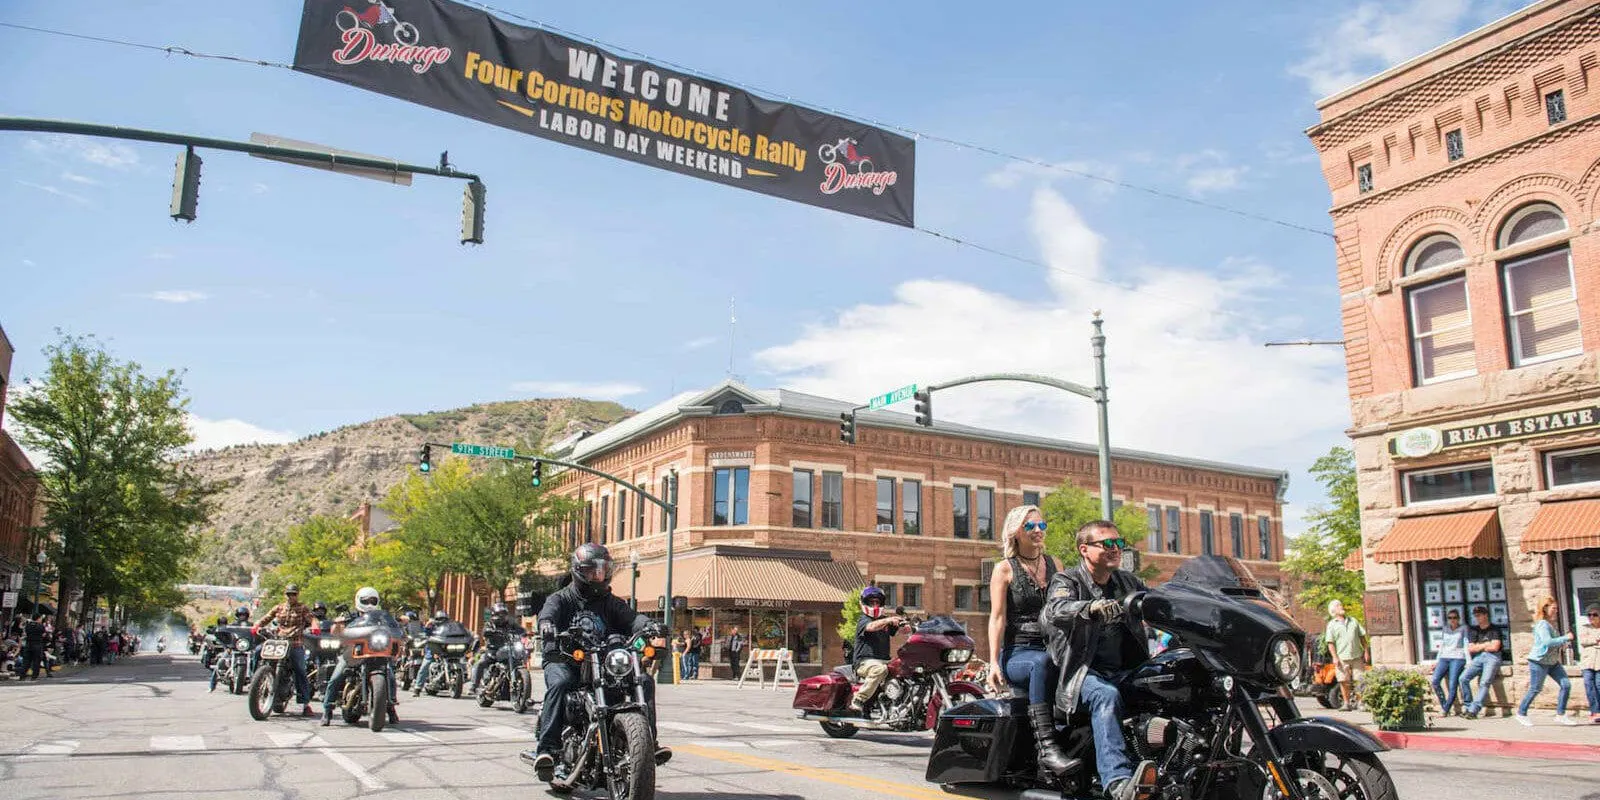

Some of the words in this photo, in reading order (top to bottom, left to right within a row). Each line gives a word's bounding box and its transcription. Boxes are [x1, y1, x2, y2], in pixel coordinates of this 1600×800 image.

[332, 27, 451, 74] Durango
[568, 48, 730, 122] WELCOME
[464, 51, 523, 93] Four
[526, 69, 624, 122] Corners
[628, 99, 751, 156] Motorcycle
[755, 134, 807, 172] Rally
[539, 108, 606, 144] LABOR
[613, 129, 650, 155] DAY
[656, 140, 742, 179] WEEKEND
[819, 162, 897, 195] Durango
[872, 394, 887, 409] MAIN
[890, 386, 912, 404] AVENUE
[1449, 424, 1502, 445] REAL
[1508, 408, 1593, 435] ESTATE
[457, 445, 474, 455] 9TH
[479, 447, 509, 458] STREET
[263, 644, 286, 656] 28
